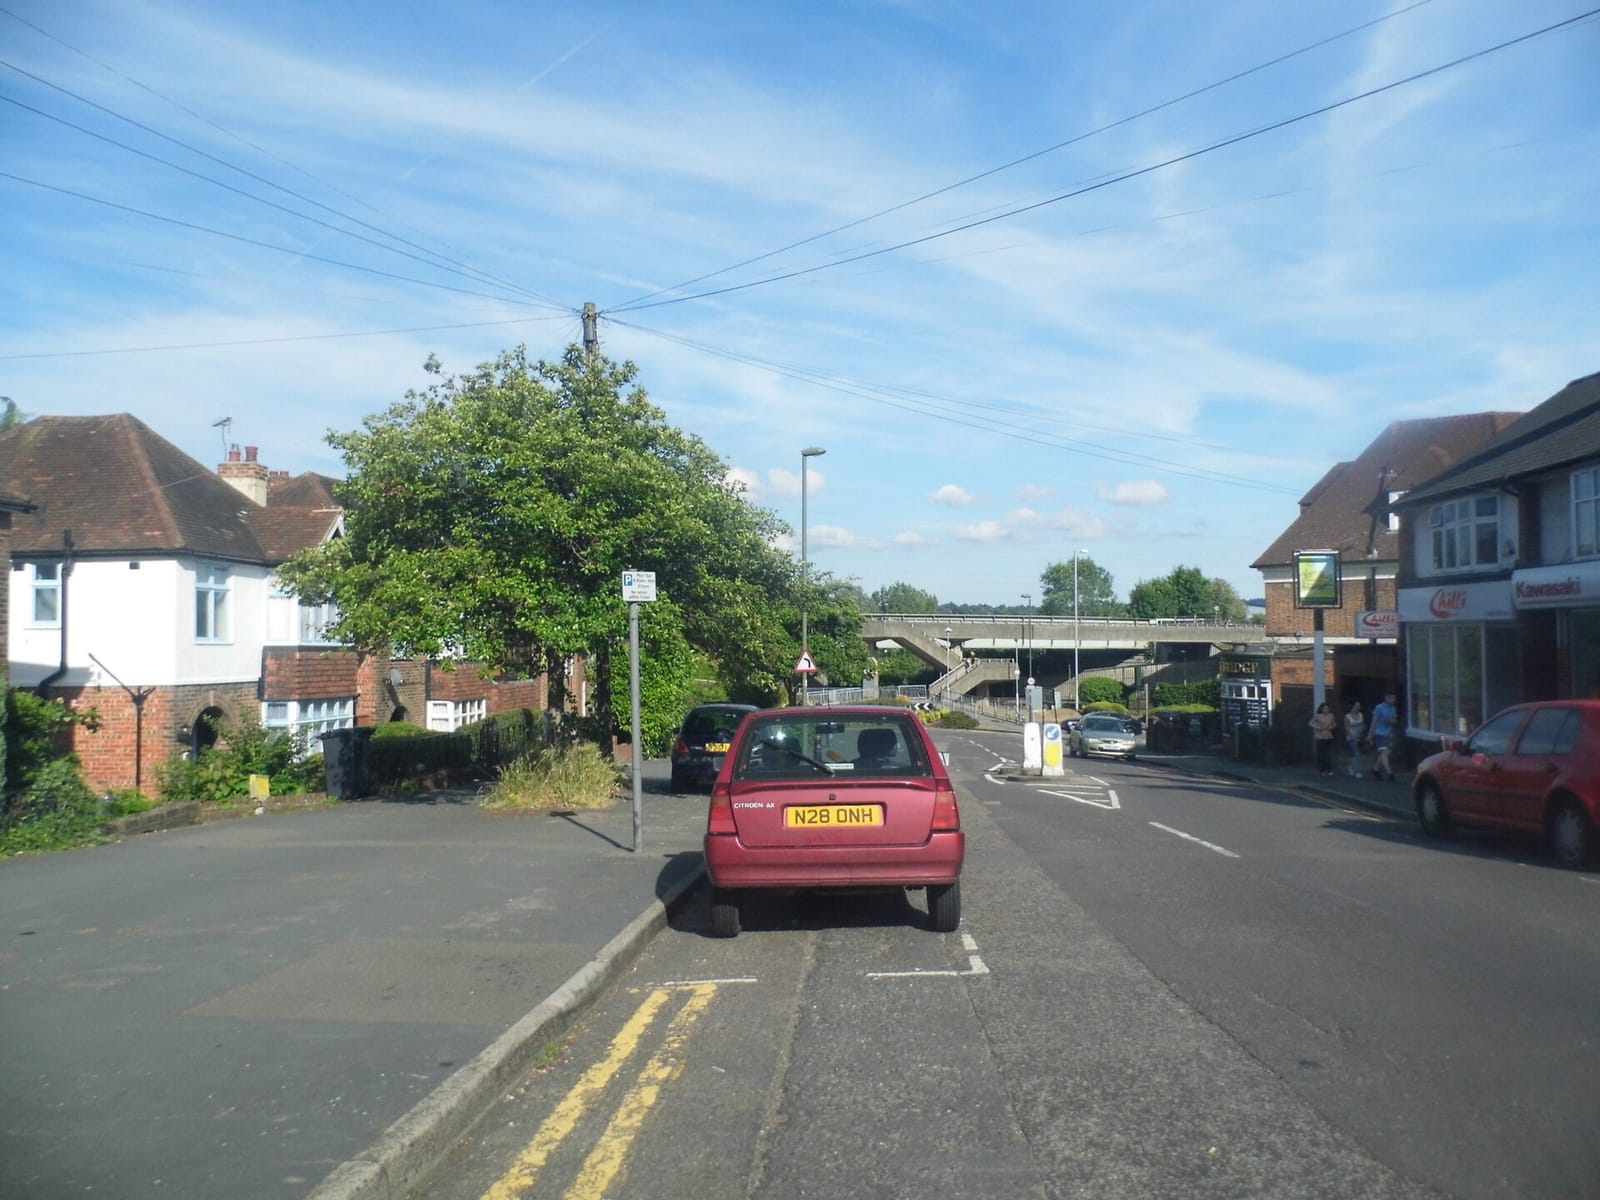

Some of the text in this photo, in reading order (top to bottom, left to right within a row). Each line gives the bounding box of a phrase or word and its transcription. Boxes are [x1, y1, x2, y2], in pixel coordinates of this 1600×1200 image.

[1516, 577, 1581, 598] Kawasaki
[1430, 588, 1467, 618] Chilli
[795, 808, 873, 824] N28 ONH
